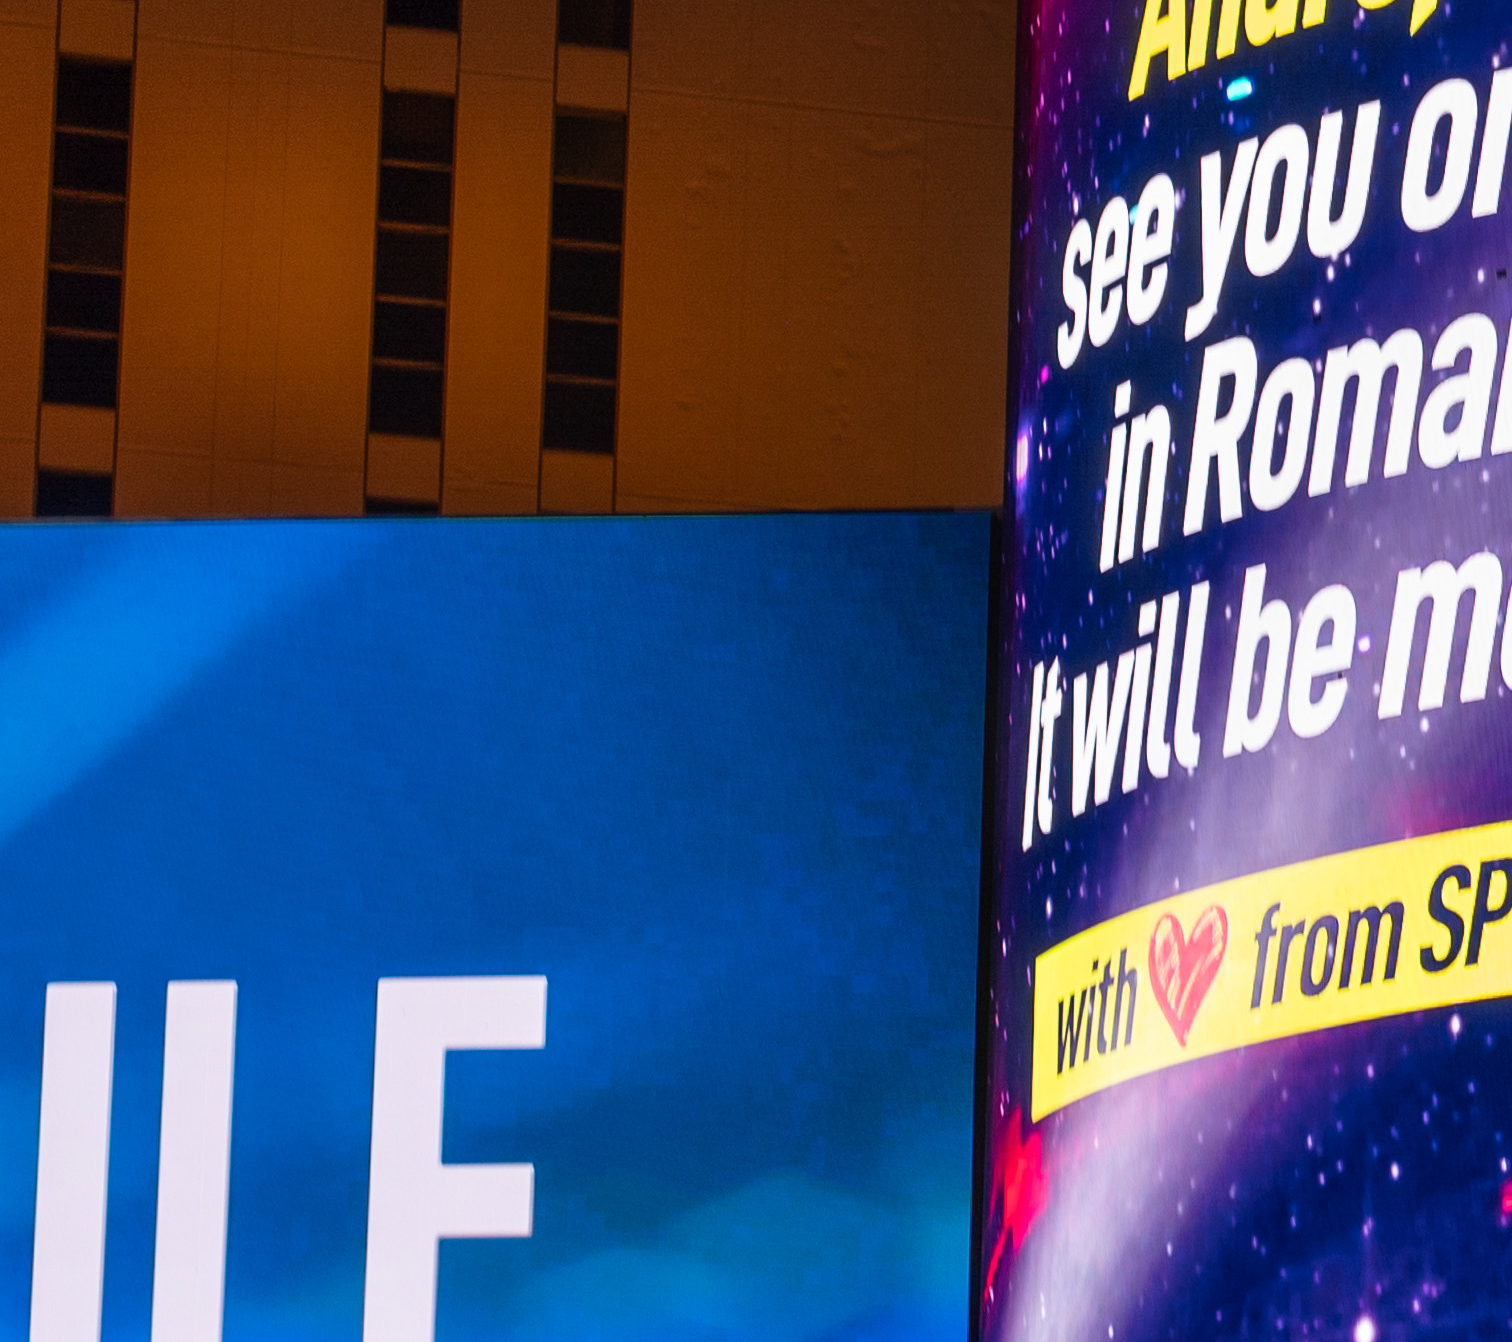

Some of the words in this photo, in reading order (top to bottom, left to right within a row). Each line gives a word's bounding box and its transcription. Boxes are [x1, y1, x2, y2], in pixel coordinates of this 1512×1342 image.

[1055, 171, 1175, 369] see
[1184, 99, 1382, 340] you
[1098, 380, 1173, 572] in
[1022, 660, 1069, 851] It
[1070, 583, 1208, 817] will
[1223, 563, 1359, 757] be
[1054, 944, 1139, 1076] with
[1251, 883, 1402, 1010] from
